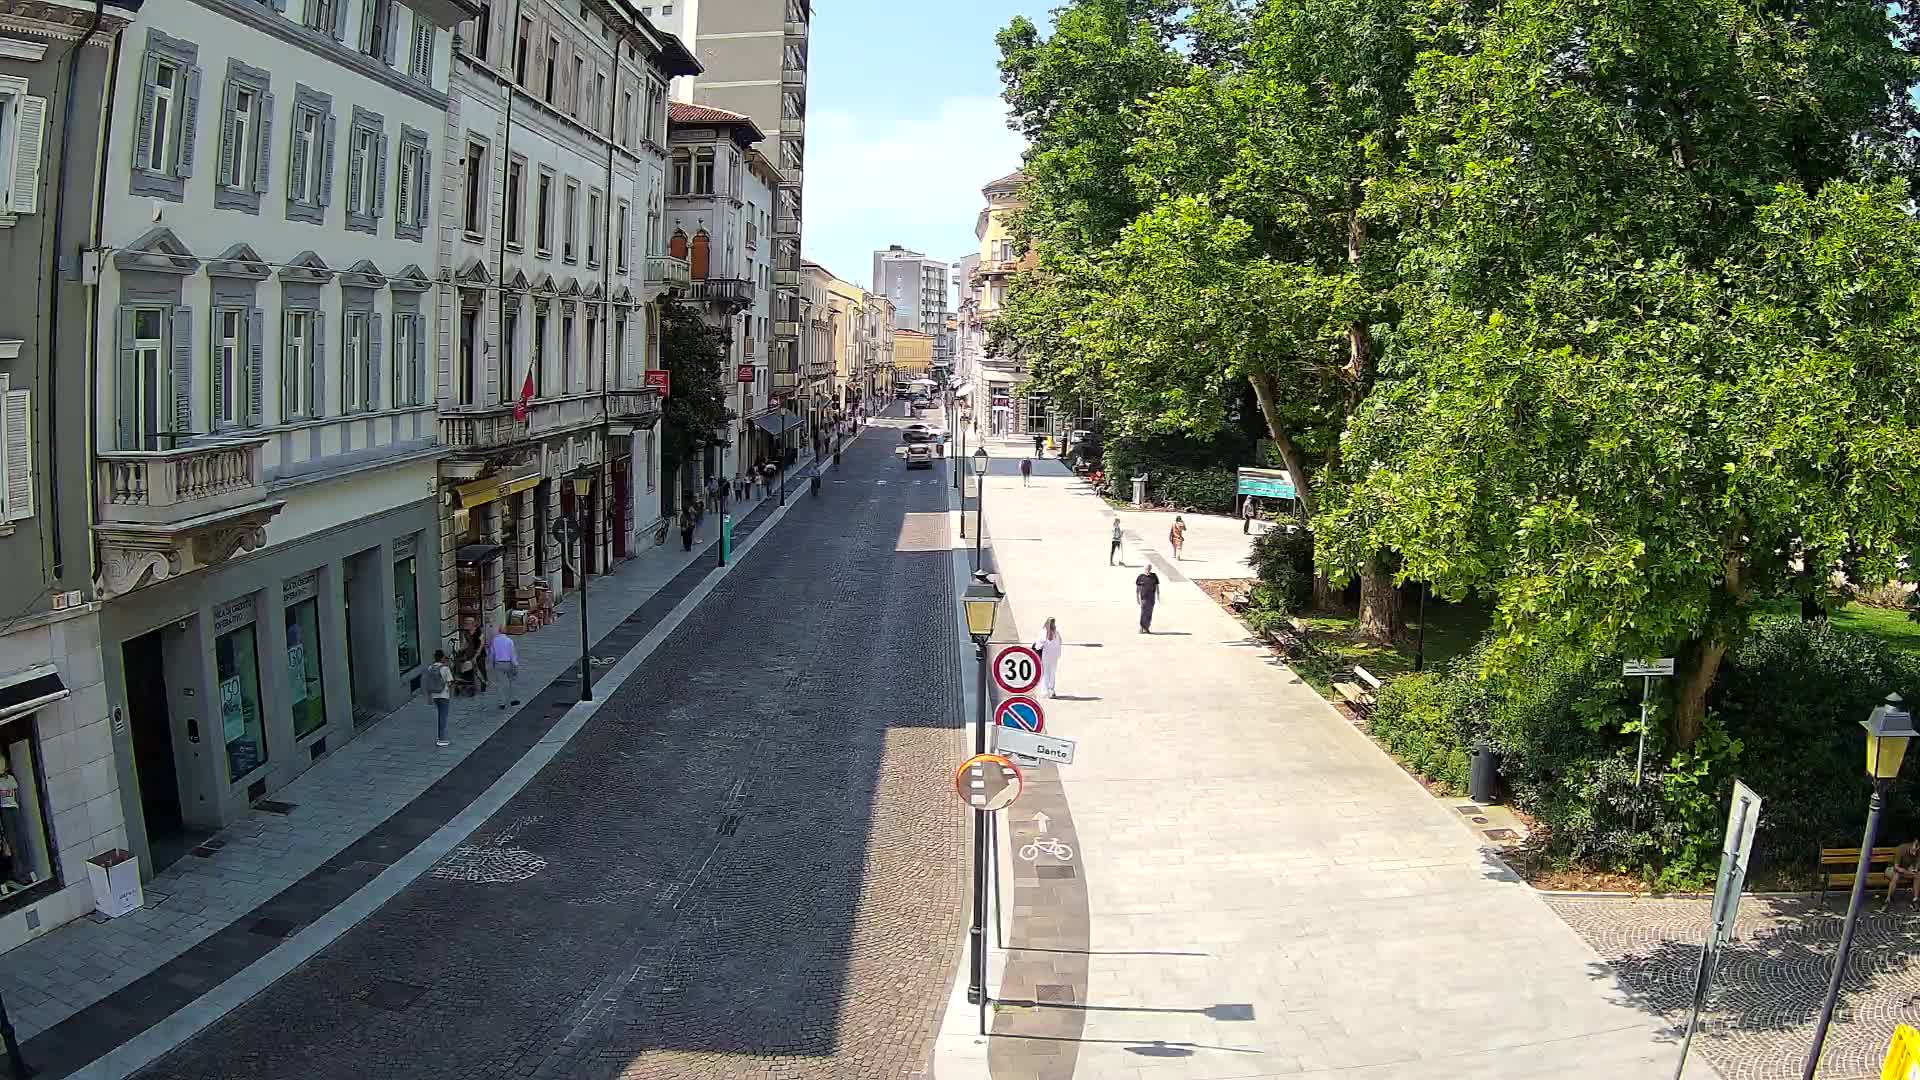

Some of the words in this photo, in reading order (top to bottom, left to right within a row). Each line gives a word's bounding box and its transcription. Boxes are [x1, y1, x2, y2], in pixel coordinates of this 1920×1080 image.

[1004, 659, 1032, 681] 30
[223, 679, 240, 702] 130
[1037, 745, 1067, 758] Dante
